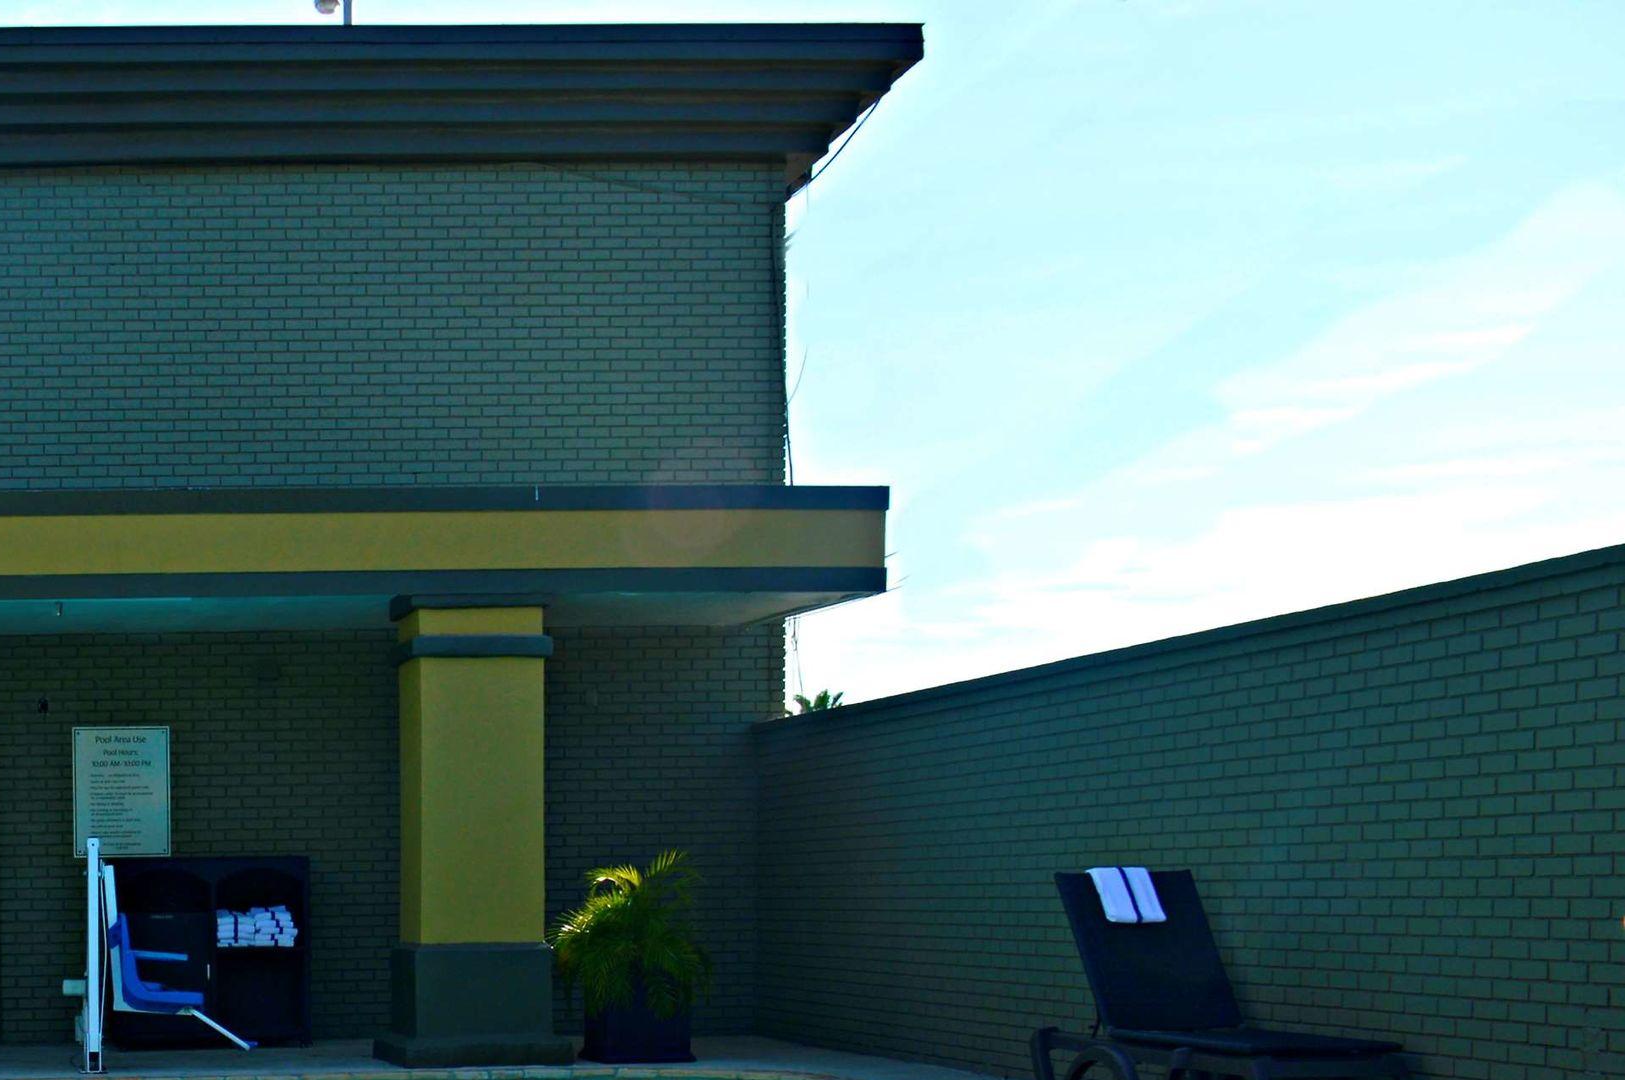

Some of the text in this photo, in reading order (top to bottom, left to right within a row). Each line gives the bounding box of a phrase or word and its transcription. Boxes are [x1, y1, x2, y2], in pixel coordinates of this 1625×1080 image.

[95, 735, 147, 744] Pool Area Use
